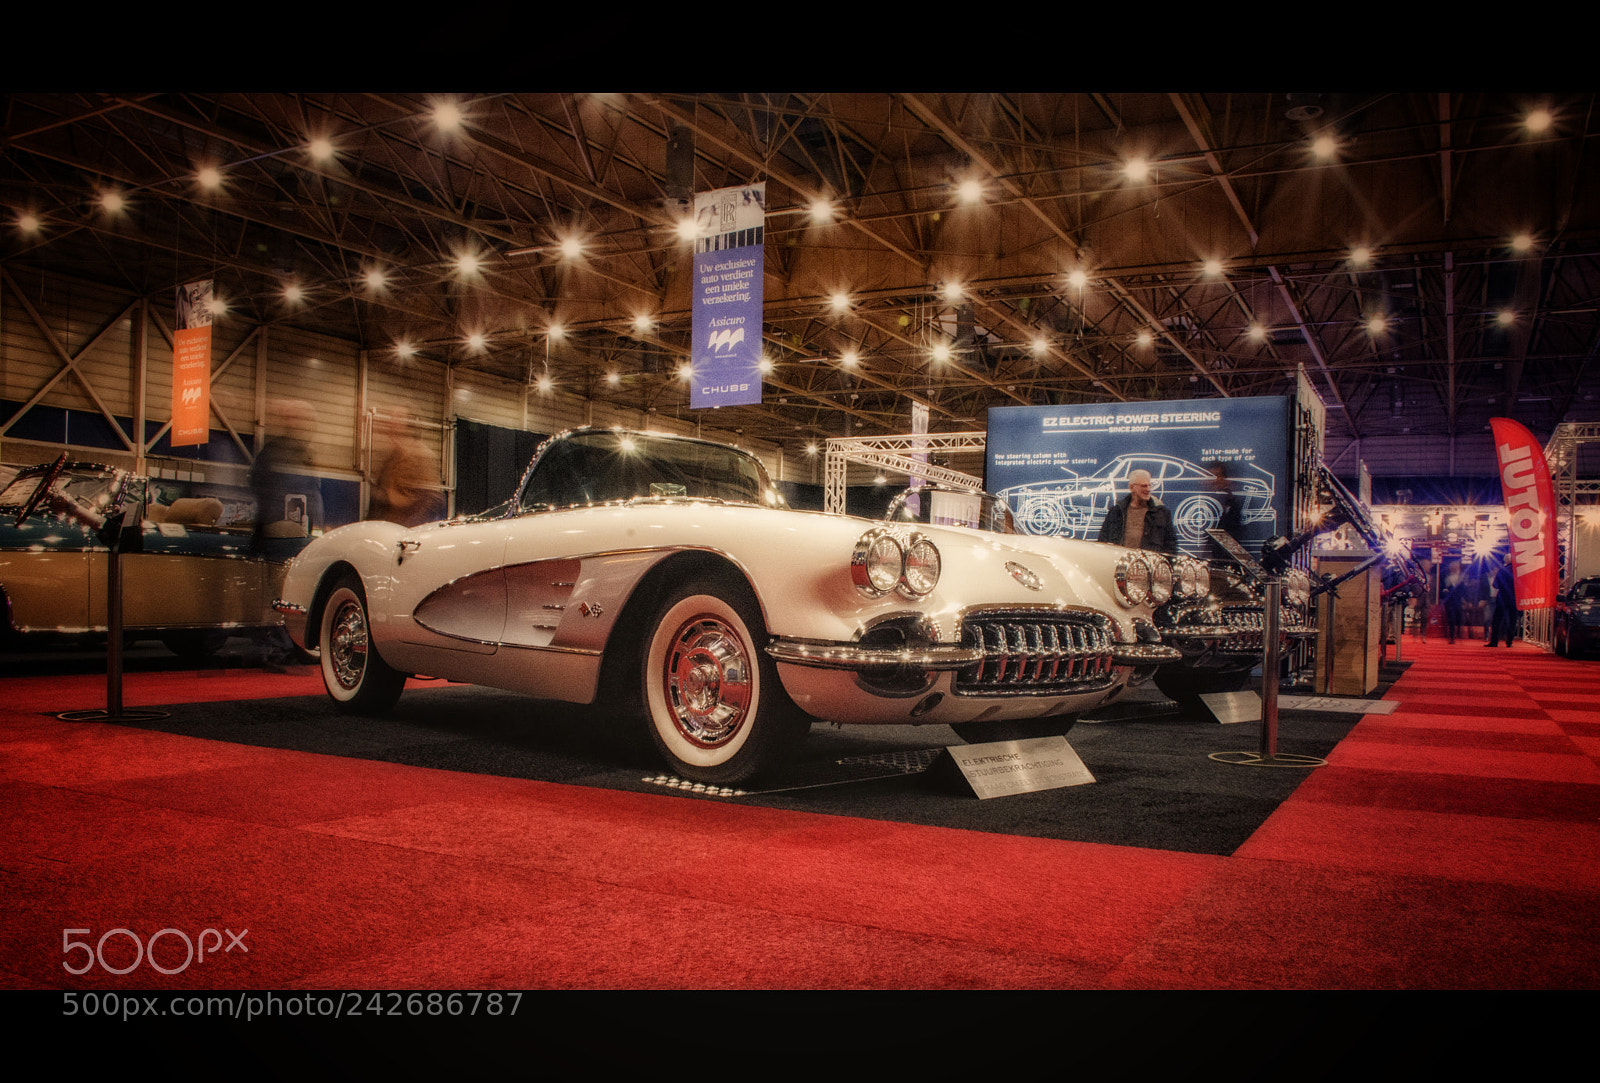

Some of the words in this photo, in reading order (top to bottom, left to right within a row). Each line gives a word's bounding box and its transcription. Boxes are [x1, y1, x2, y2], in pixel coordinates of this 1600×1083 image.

[700, 264, 713, 273] Uw
[714, 258, 756, 271] exclusieve
[701, 274, 719, 284] auto
[720, 269, 754, 281] verdient
[705, 284, 720, 294] een
[722, 280, 750, 292] unieke
[702, 292, 752, 305] verzekering.
[708, 316, 746, 327] Assicuro
[702, 383, 750, 394] CHUBB
[1043, 416, 1058, 427] EZ
[1059, 415, 1115, 427] ELECTRIC
[1116, 413, 1159, 425] POWER
[1160, 411, 1221, 423] STEERING
[1127, 425, 1149, 433] 2007
[1006, 452, 1031, 460] steering
[1218, 455, 1232, 463] type
[962, 753, 1022, 767] ELEKTRISCHE
[969, 758, 1064, 778] STUURBEKRACHTIGING
